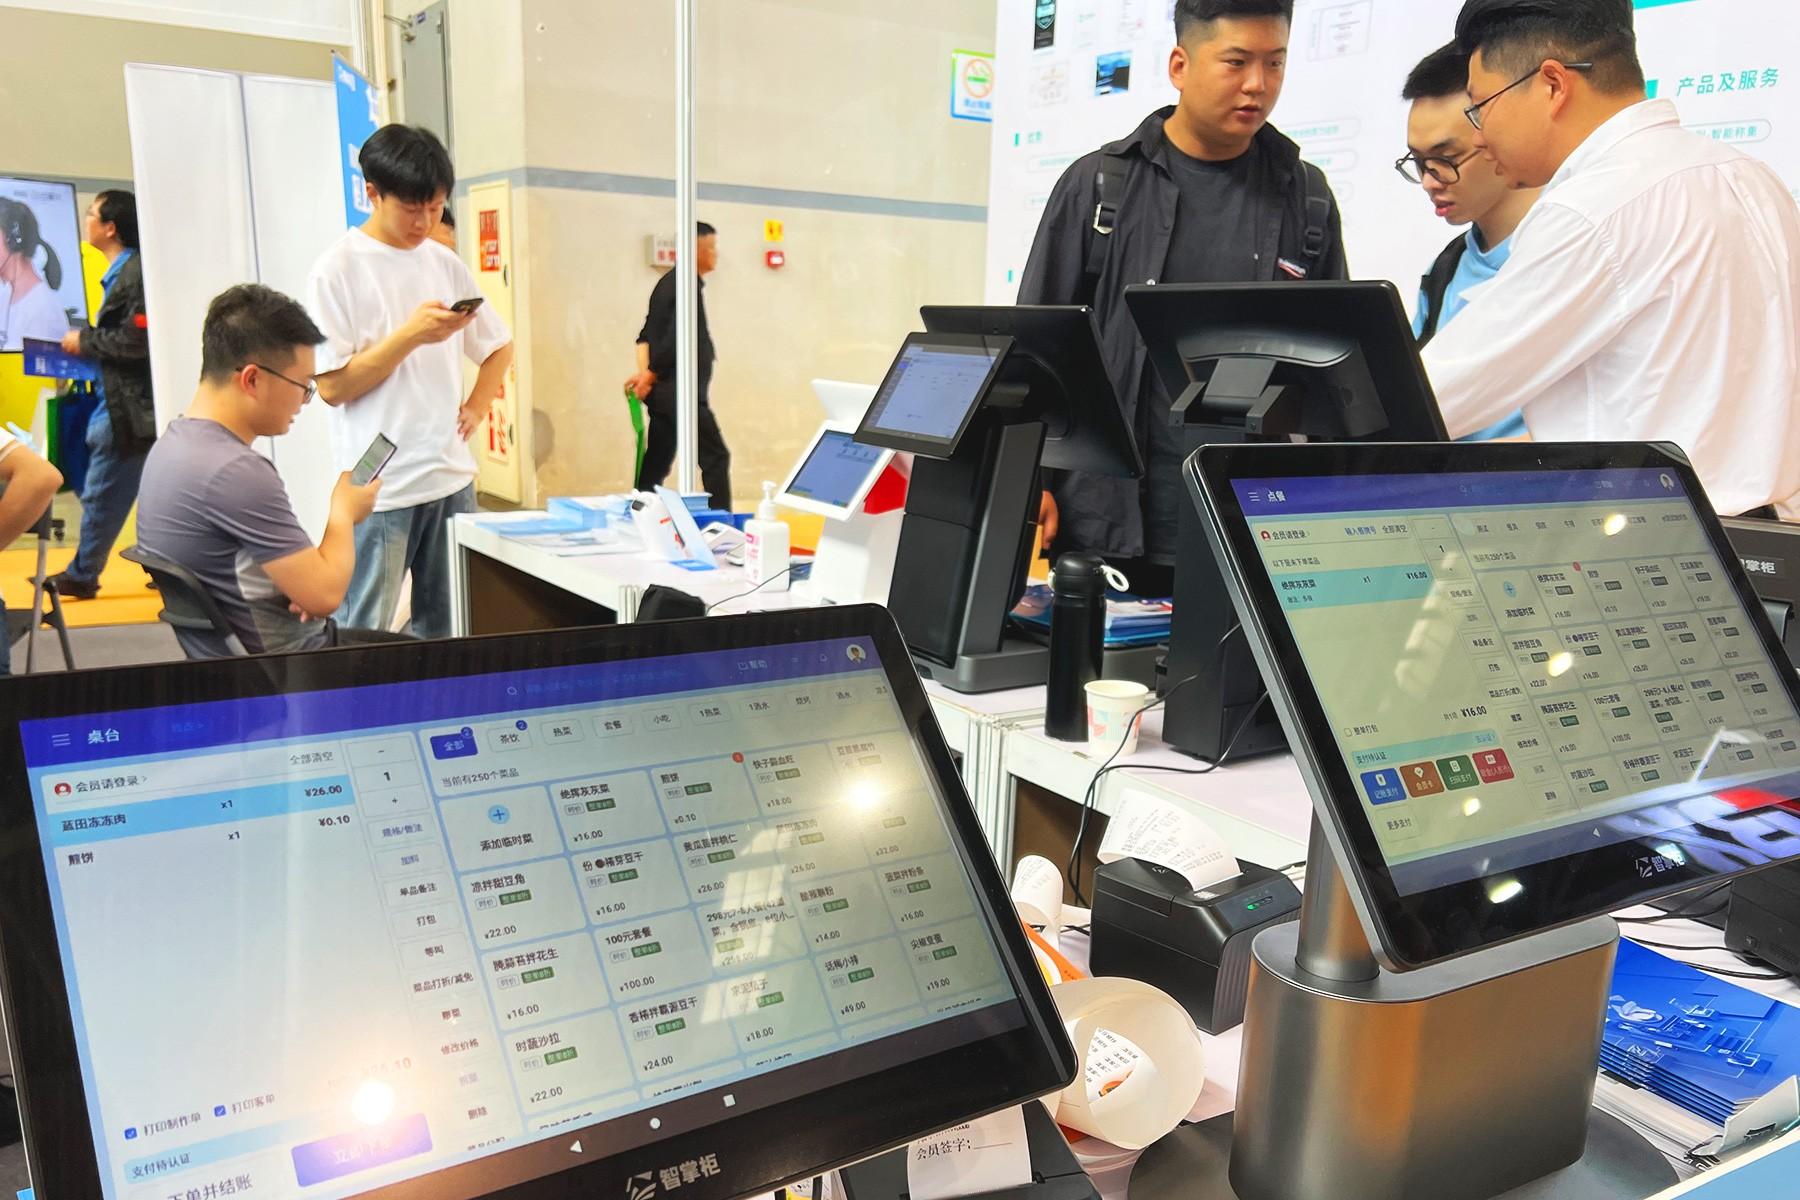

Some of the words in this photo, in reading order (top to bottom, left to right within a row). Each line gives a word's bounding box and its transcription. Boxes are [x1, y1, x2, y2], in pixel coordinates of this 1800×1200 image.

[1677, 67, 1779, 97] 产品及服务
[1265, 491, 1286, 501] 点餐
[1271, 529, 1307, 539] 会员请登录
[1740, 558, 1776, 574] 掌柜
[1406, 571, 1428, 579] ¥16.00
[1461, 706, 1486, 717] ¥16.00
[86, 728, 120, 743] 桌台
[443, 740, 465, 751] 全部
[499, 733, 520, 744] 茶饮
[552, 727, 572, 737] 热菜
[289, 751, 333, 764] 全部清空
[383, 771, 391, 781] 1
[441, 768, 519, 787] 当前有250个菜品
[75, 775, 138, 792] 会员请登录
[220, 799, 234, 808] x1
[305, 785, 342, 797] ¥26.00
[672, 813, 697, 824] ¥0.10
[67, 852, 93, 865] 煎饼
[227, 830, 241, 840] x1
[319, 815, 350, 826] ¥0.10
[480, 834, 533, 850] 添加临时菜
[573, 830, 603, 840] ¥16.00
[400, 883, 436, 895] 单品备注
[697, 881, 724, 892] ¥26.00
[596, 903, 626, 914] ¥16.00
[417, 915, 435, 925] 打包
[900, 911, 924, 921] ¥16.00
[484, 926, 516, 938] ¥22.00
[605, 927, 651, 944] 100元套餐
[414, 972, 472, 991] 菜品打折/减免
[619, 976, 654, 990] ¥100.00
[926, 978, 950, 989] ¥19.00
[506, 1004, 539, 1018] ¥16.00
[840, 1001, 866, 1014] ¥49.00
[746, 1027, 774, 1040] ¥18.00
[516, 1033, 560, 1052] 时蔬沙拉
[643, 1056, 673, 1070] ¥24.00
[530, 1087, 563, 1102] ¥22.00
[132, 1153, 192, 1178] 支付待认证
[658, 1152, 721, 1191] 智掌柜
